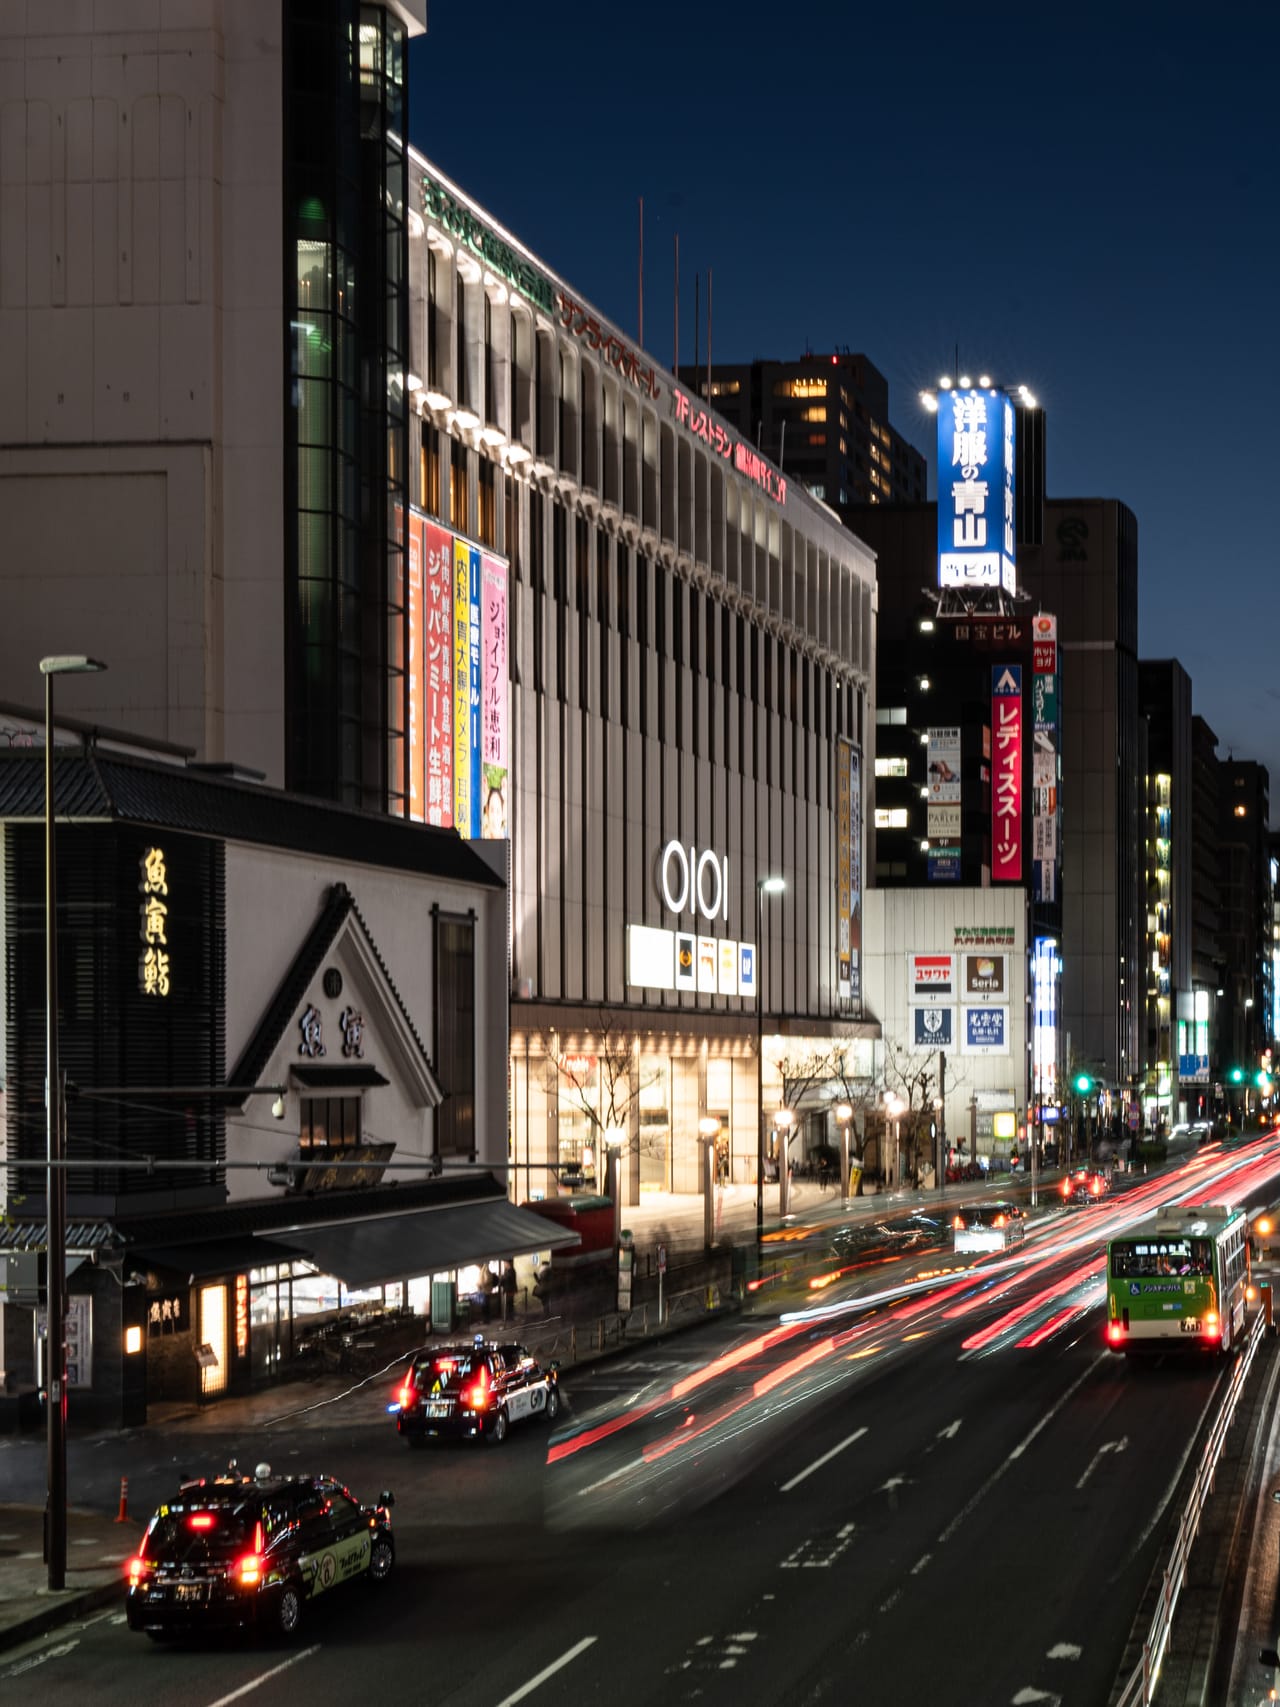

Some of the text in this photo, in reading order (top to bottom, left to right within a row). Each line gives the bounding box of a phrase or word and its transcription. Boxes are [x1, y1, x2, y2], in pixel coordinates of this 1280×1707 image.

[951, 395, 989, 548] 洋服の青山
[996, 703, 1019, 864] レディススーツ
[972, 978, 999, 988] Seria
